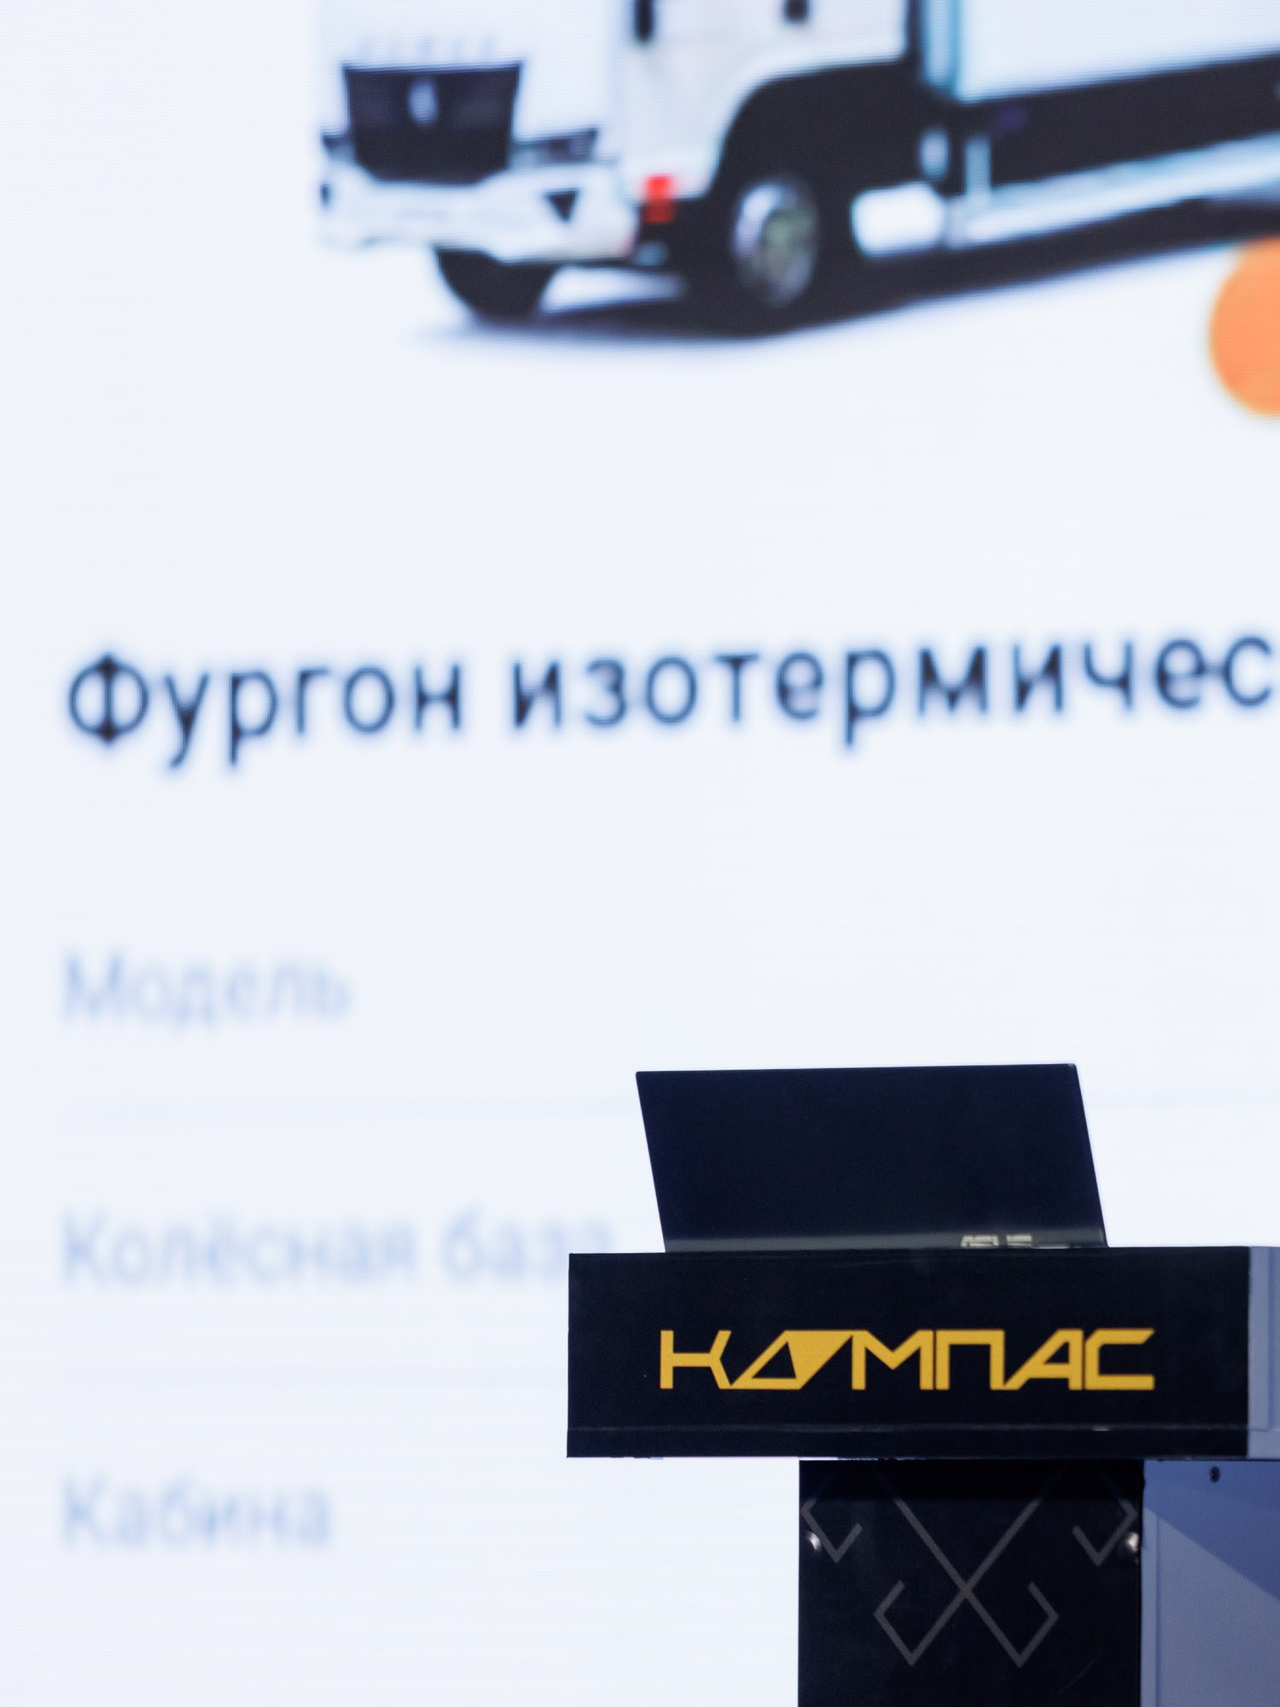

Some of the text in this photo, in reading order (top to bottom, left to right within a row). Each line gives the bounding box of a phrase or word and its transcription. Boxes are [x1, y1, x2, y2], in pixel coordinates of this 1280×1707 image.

[67, 652, 463, 770] Фургон
[62, 950, 352, 1027] Модель
[61, 1213, 419, 1284] Колёсная
[62, 1475, 333, 1548] Кабина
